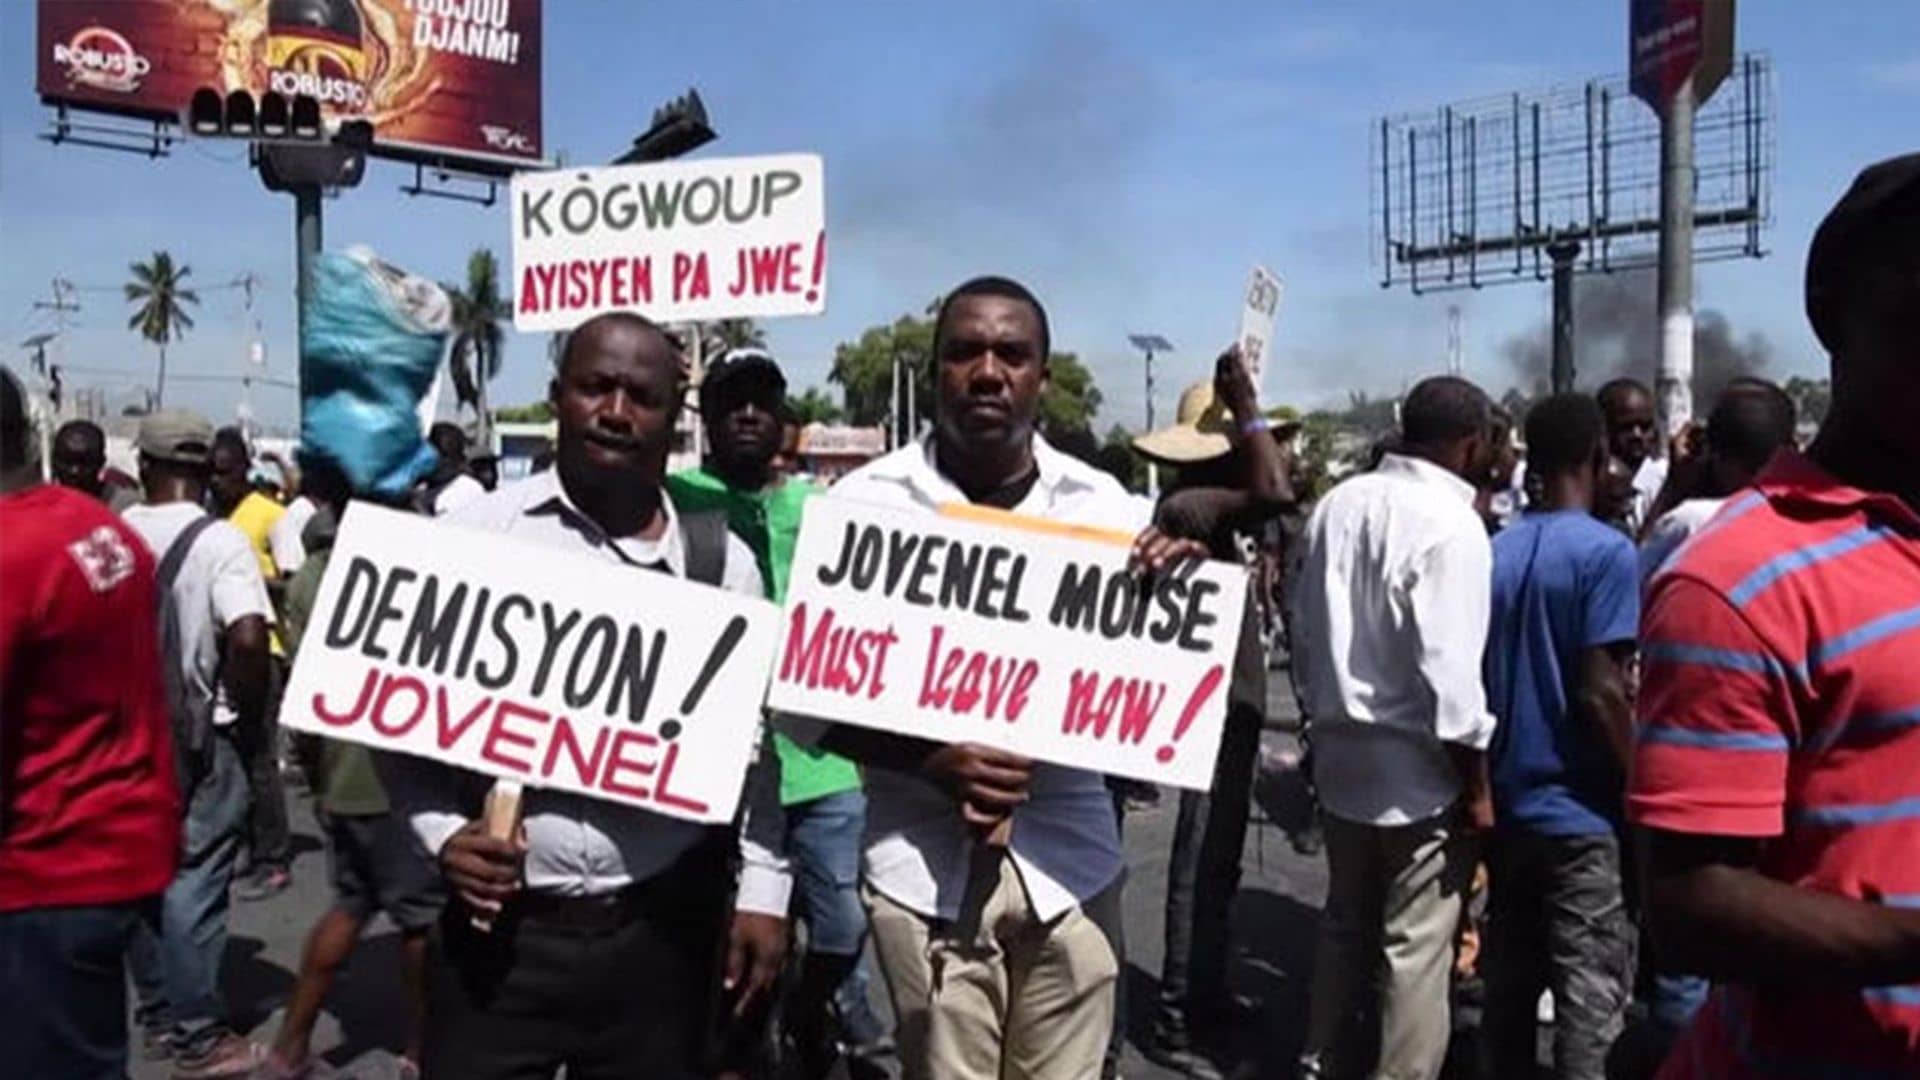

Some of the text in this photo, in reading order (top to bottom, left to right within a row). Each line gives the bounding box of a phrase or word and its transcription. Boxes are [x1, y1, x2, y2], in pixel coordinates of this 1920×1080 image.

[403, 0, 508, 28] UJOU
[414, 15, 519, 64] DJANM!
[270, 70, 366, 107] ROBUSTO
[521, 171, 802, 238] KÒGWOUP
[520, 229, 826, 314] AYISYEN PA JWE!
[818, 521, 1030, 622] JOVENEL
[779, 602, 1225, 764] Must leave now!
[312, 668, 709, 814] JOVENEL
